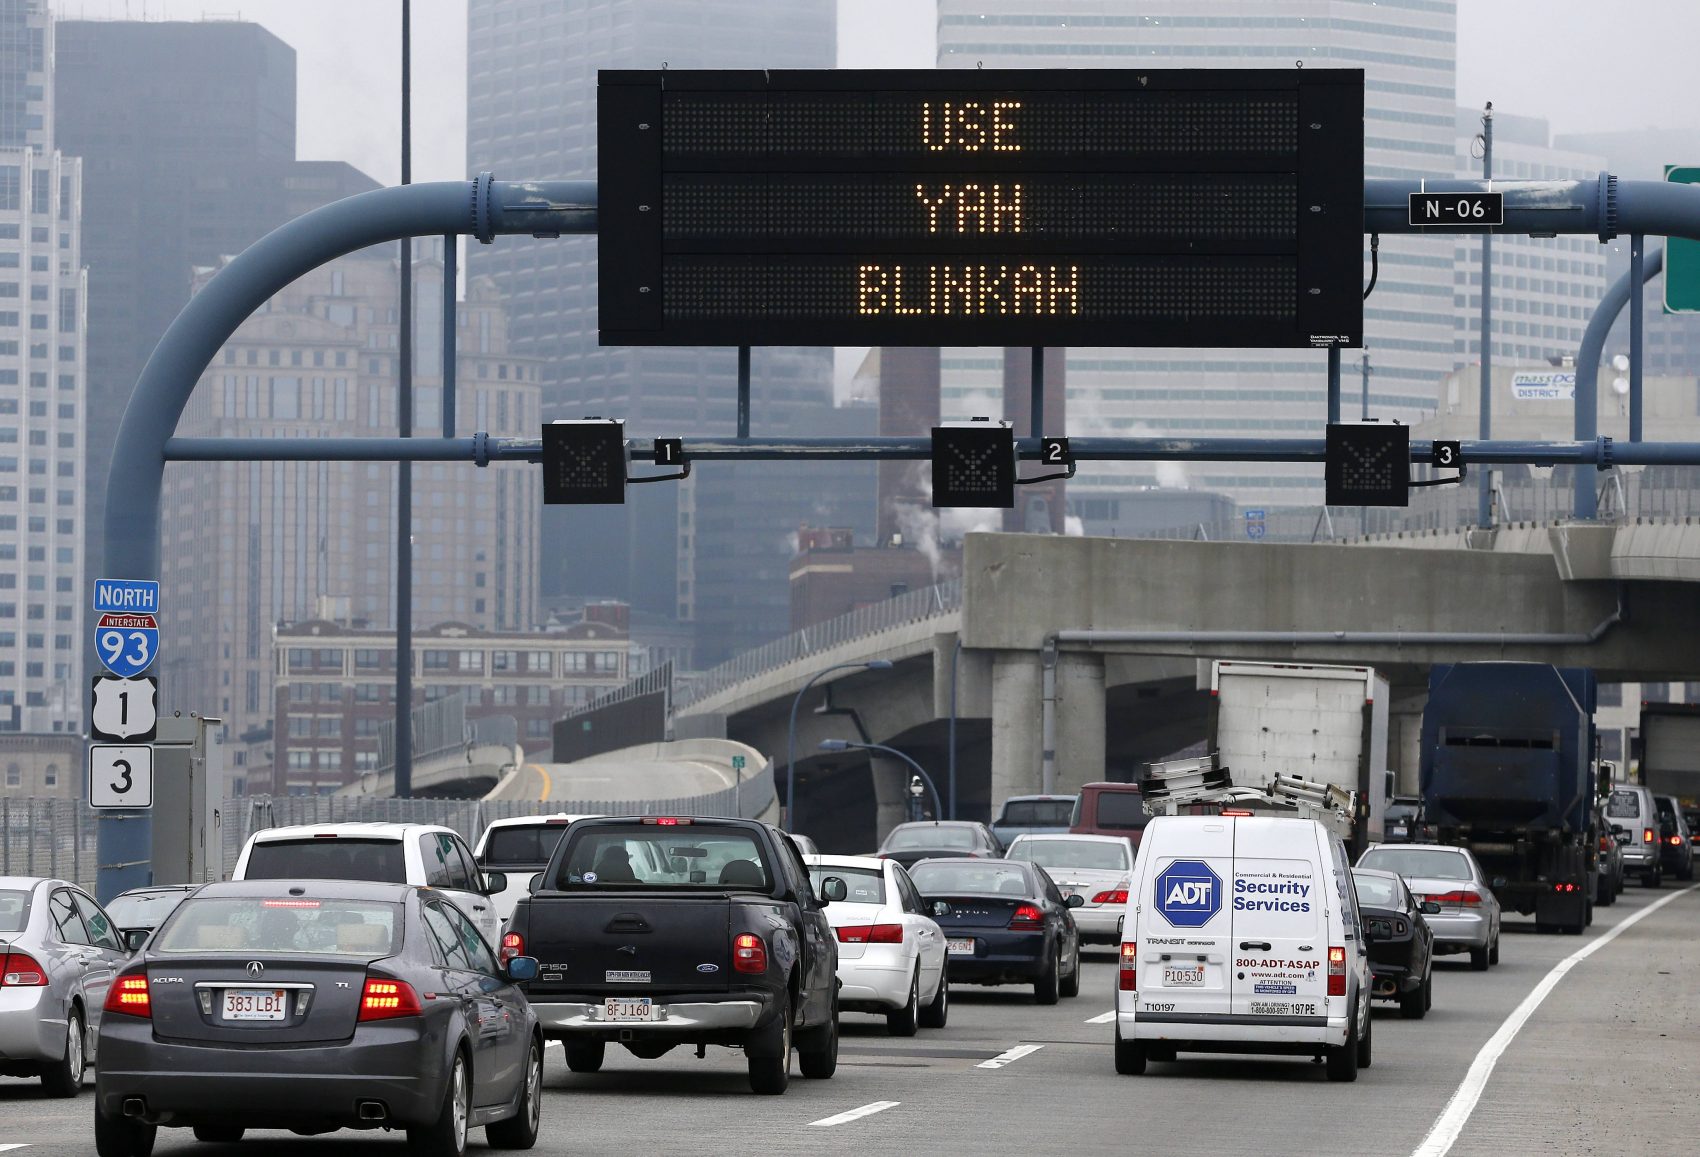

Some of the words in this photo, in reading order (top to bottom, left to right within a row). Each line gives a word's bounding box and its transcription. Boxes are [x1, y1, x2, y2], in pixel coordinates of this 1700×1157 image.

[923, 102, 1021, 151] USE
[916, 184, 1021, 233] YAH
[1426, 199, 1485, 218] N-06
[859, 265, 1078, 315] BLINKAH
[1519, 389, 1559, 398] DISTRICT
[665, 443, 671, 461] 1
[1049, 443, 1062, 461] 2
[1440, 446, 1452, 464] 3
[100, 585, 154, 607] NORTH
[106, 618, 150, 627] INTERSTATE
[101, 631, 149, 666] 93
[119, 691, 128, 725] 1
[110, 759, 133, 794] 3
[1166, 881, 1212, 905] ADT
[1234, 879, 1310, 898] Security
[1233, 896, 1310, 913] Services
[1146, 937, 1186, 945] TRANSIT
[1236, 958, 1320, 970] 800-ADT-ASAP
[335, 981, 352, 989] TL
[226, 996, 253, 1012] 383
[256, 996, 282, 1012] LB1
[629, 1004, 649, 1016] 160
[1144, 1003, 1176, 1012] T10197
